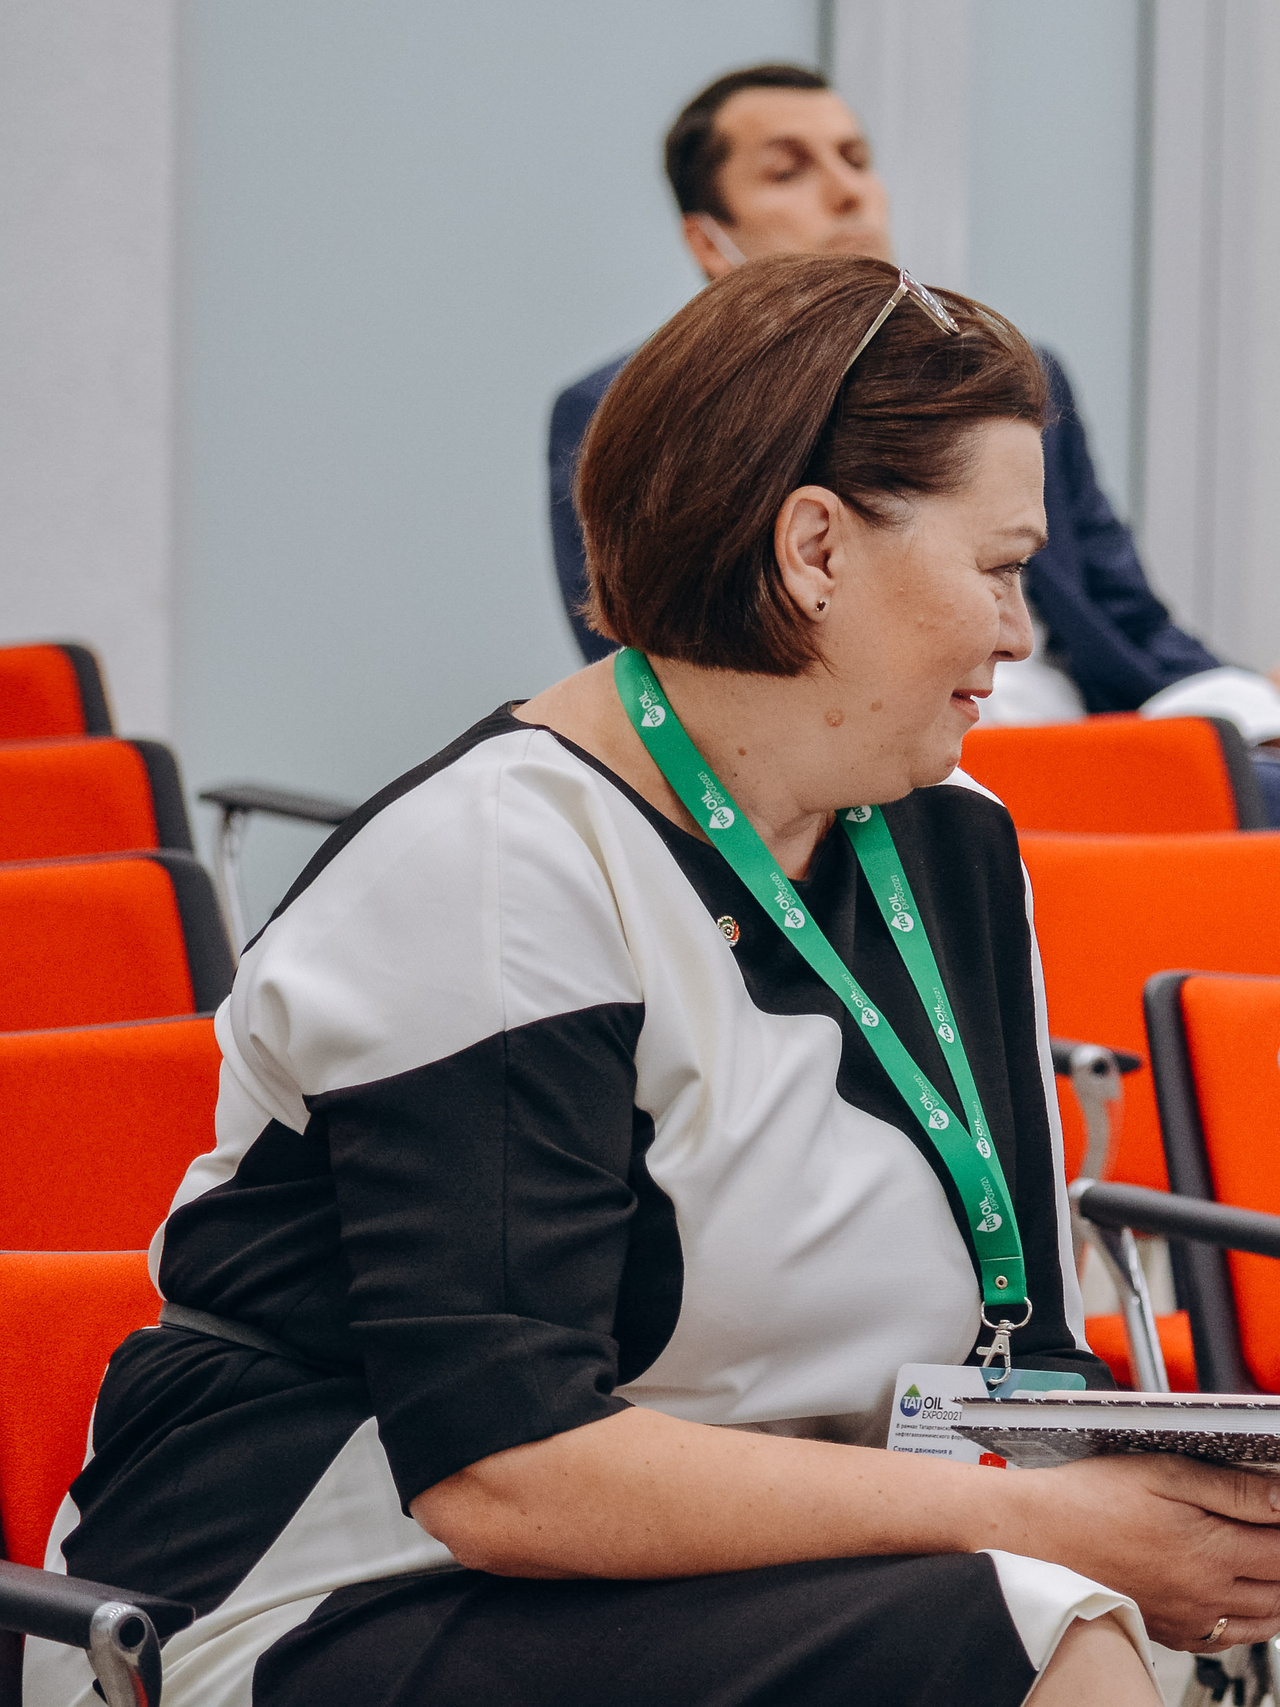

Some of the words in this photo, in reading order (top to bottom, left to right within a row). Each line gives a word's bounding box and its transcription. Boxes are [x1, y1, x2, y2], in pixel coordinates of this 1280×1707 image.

[640, 674, 660, 704] EXPO2021
[639, 690, 652, 709] OIL
[697, 771, 726, 805] EXPO2021
[701, 790, 718, 810] OIL
[770, 871, 796, 906] EXPO2021
[890, 874, 910, 911] EXPO2021
[774, 891, 790, 910] OIL
[888, 893, 902, 912] OIL
[850, 991, 863, 1008] OIL
[934, 1004, 944, 1022] OIL
[913, 1074, 940, 1107] EXPO2021
[919, 1092, 933, 1110] OIL
[974, 1118, 983, 1137] OIL
[980, 1176, 999, 1211] EXPO2021
[979, 1196, 992, 1215] OIL
[903, 1396, 922, 1409] TAT
[924, 1396, 943, 1410] OIL
[922, 1410, 962, 1421] EXPO2021
